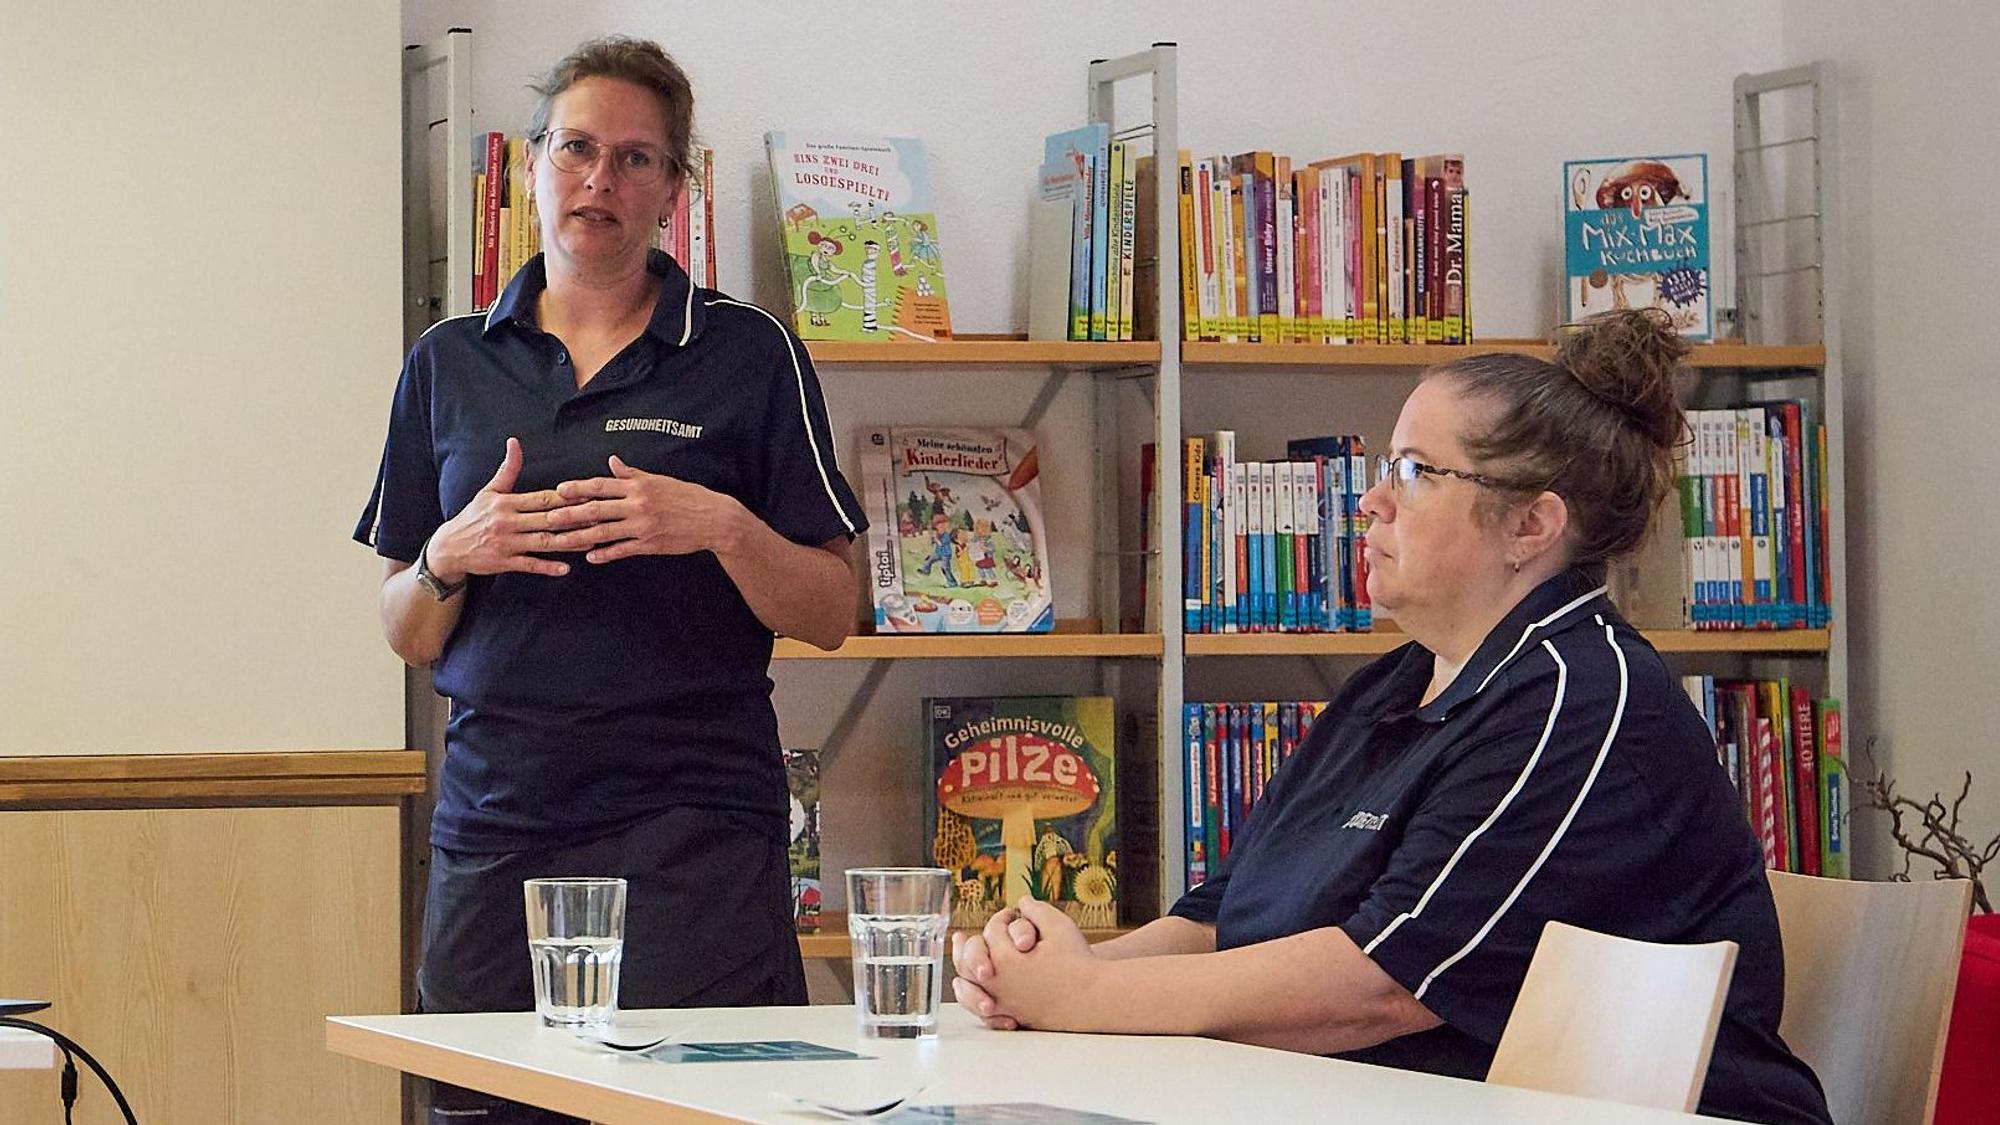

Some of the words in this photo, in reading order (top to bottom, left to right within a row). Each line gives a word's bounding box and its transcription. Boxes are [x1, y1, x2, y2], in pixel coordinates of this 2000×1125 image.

[793, 154, 819, 164] EINS
[822, 155, 849, 168] ZWEI
[853, 161, 880, 176] DREI
[795, 172, 890, 201] LOSGESPIELT!
[1122, 179, 1134, 260] KINDERSPIELE
[1264, 222, 1274, 246] Baby
[1264, 247, 1273, 274] Unser
[1446, 258, 1462, 286] Dr.
[605, 418, 703, 438] GESUNDHEITSAMT
[905, 448, 999, 470] Kinderlieder
[917, 438, 944, 449] Meine
[947, 443, 993, 454] schönsten
[876, 551, 896, 588] tiptoi
[944, 716, 1084, 748] Geheimnisvolle
